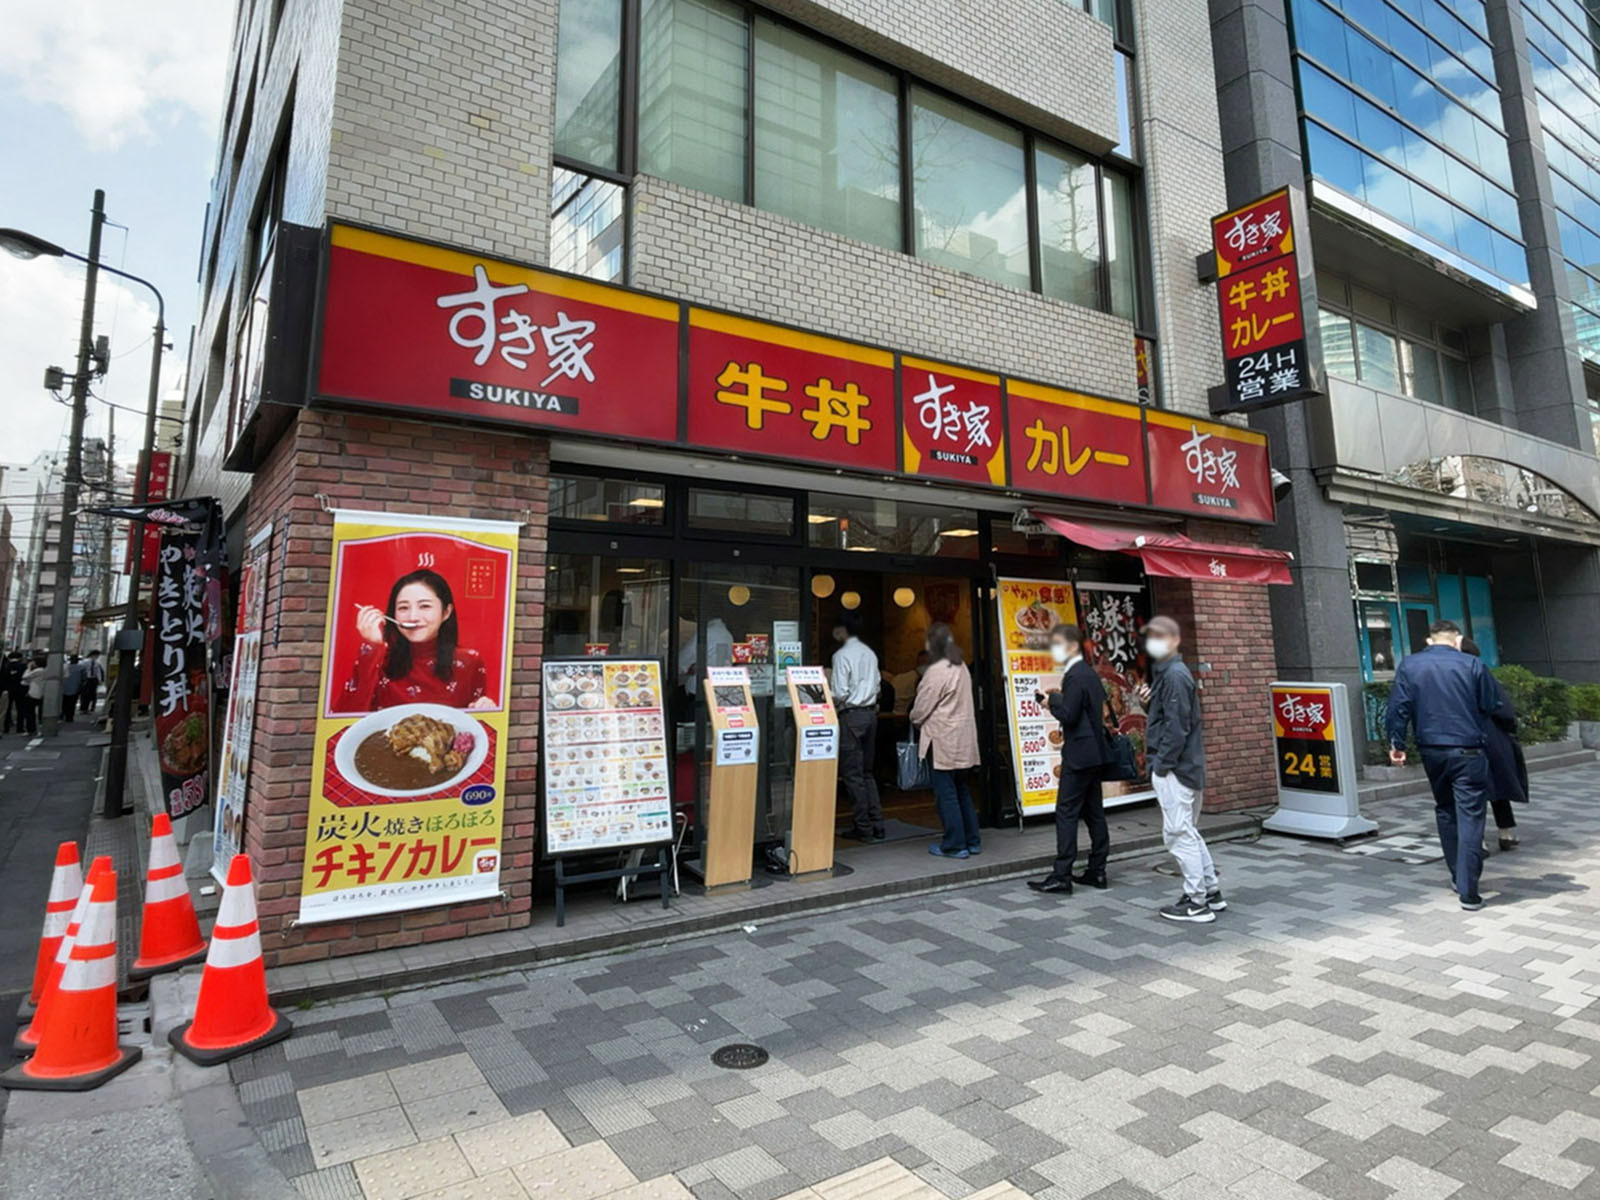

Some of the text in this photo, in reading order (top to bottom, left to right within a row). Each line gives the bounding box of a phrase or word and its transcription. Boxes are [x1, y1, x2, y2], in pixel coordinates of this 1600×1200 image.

[1224, 210, 1284, 252] すき家
[1229, 267, 1290, 311] 牛丼
[437, 264, 595, 387] すき家
[1230, 312, 1295, 349] カレー
[1237, 368, 1300, 401] 営業
[1238, 349, 1296, 379] 24H
[470, 383, 561, 411] SUKIYA
[715, 361, 872, 445] 牛丼
[913, 374, 992, 452] すき家
[936, 451, 972, 464] SUKIYA
[1024, 419, 1130, 476] カレー
[1181, 424, 1240, 493] すき家
[1198, 494, 1231, 509] SUKIYA
[159, 545, 192, 716] やきとり丼
[1102, 595, 1128, 673] 炭火の
[1279, 694, 1326, 727] すき家
[1284, 752, 1316, 776] 24
[311, 835, 496, 889] チキンカレー
